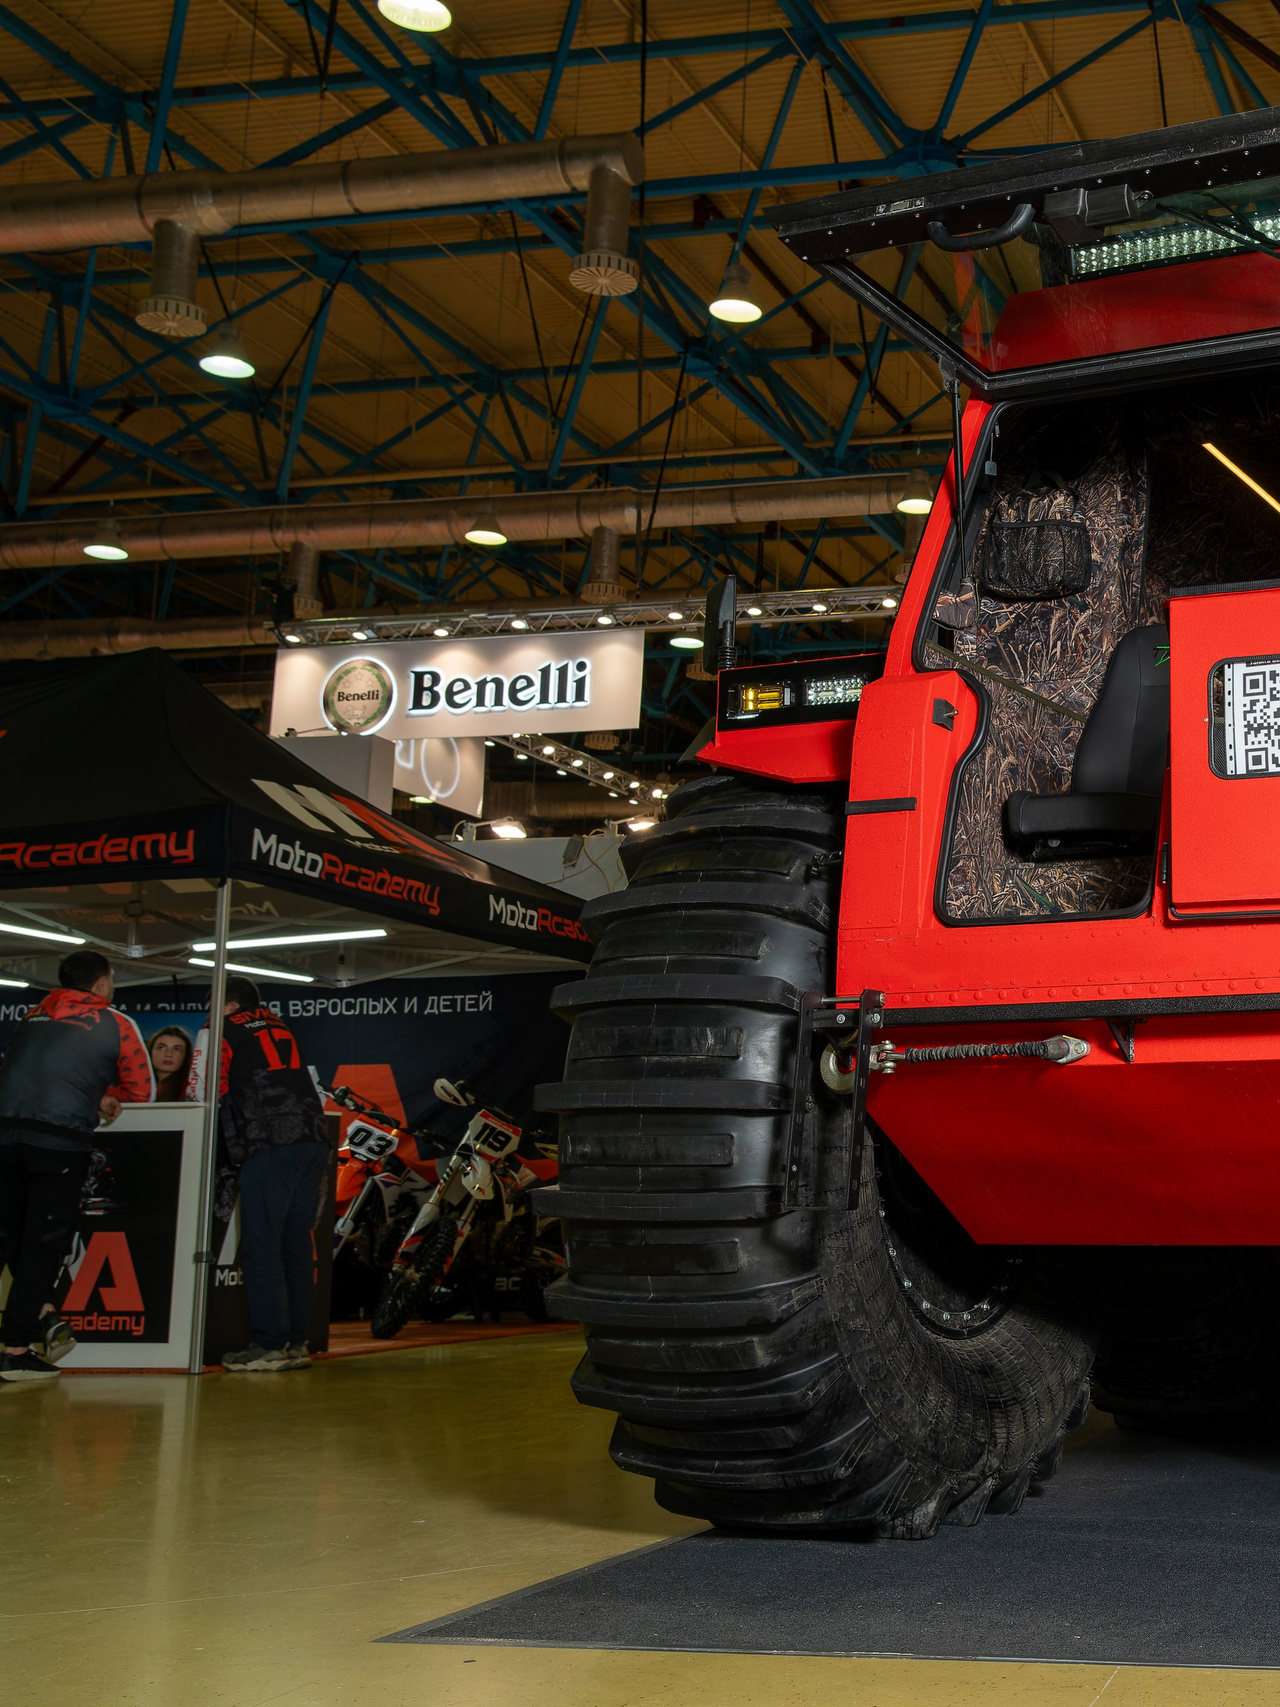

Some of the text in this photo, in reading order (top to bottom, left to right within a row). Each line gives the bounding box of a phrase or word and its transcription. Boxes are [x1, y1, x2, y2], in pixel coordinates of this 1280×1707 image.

[337, 689, 380, 703] Benelli
[408, 660, 589, 712] Benelli
[251, 828, 440, 915] MotoAcademy
[488, 893, 592, 943] MotoAcad
[289, 997, 398, 1017] ВЗРОСЛЫХ
[404, 996, 417, 1014] И
[424, 990, 493, 1015] ДЕТЕЙ
[253, 1028, 300, 1071] 17
[349, 1127, 394, 1156] 03
[473, 1122, 512, 1153] 119
[60, 1312, 145, 1336] ademy
